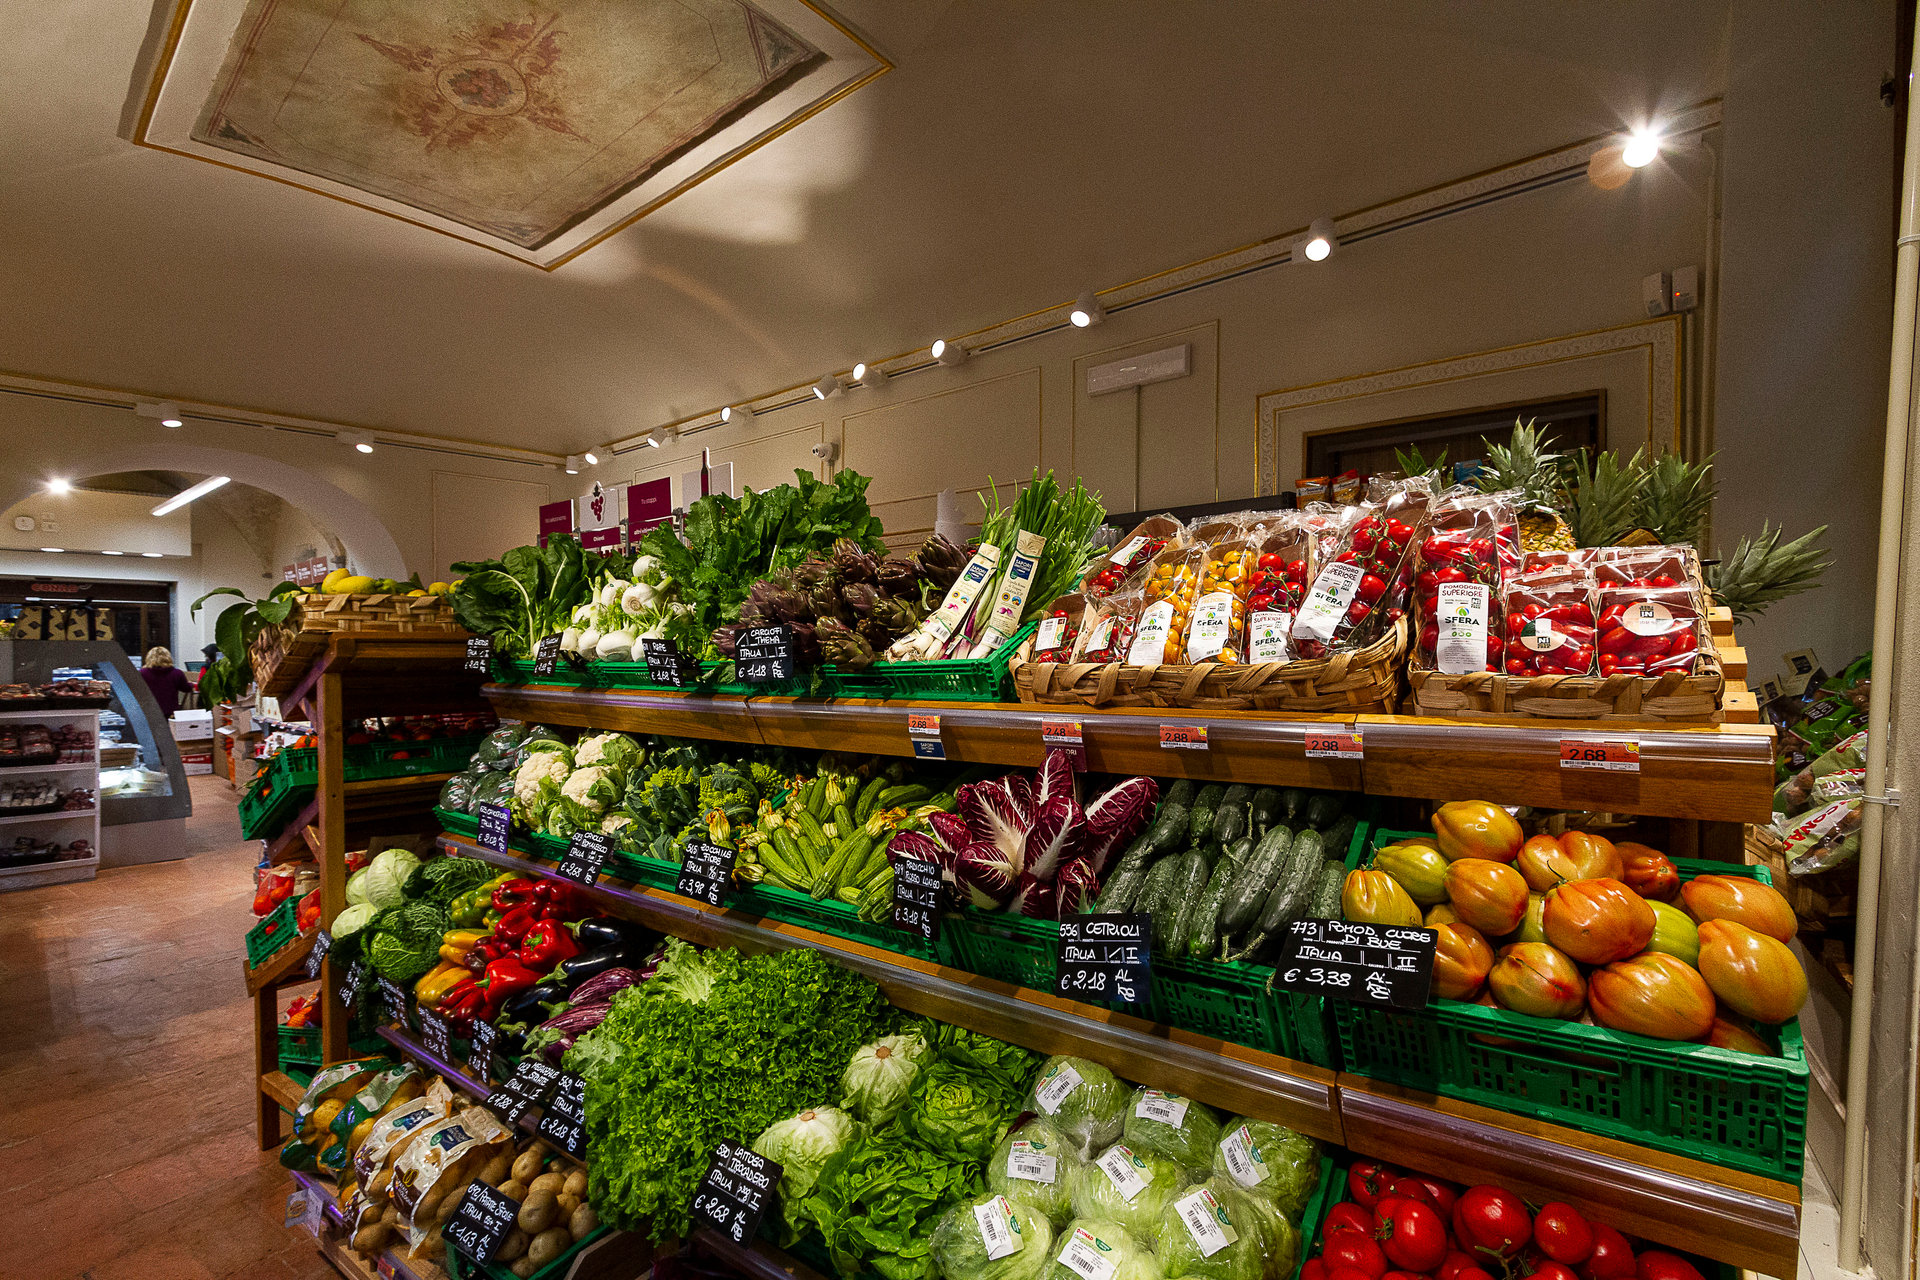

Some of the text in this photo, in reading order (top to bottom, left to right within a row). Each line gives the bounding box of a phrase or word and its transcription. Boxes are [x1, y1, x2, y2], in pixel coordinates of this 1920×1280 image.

[1442, 589, 1483, 597] SUPERIORE
[1444, 616, 1480, 626] SFERA
[1255, 637, 1282, 647] SFERA
[747, 664, 767, 678] 1,18
[1165, 732, 1188, 743] 2.88
[1311, 740, 1339, 751] 2.98
[1569, 748, 1606, 761] 2.68
[906, 860, 935, 875] RADICCHIO
[685, 879, 705, 895] 3,98
[902, 907, 919, 924] 3,18
[1059, 922, 1140, 937] 556 CETRIOLI
[1291, 920, 1431, 943] 773 POMOD. CUORE
[1343, 934, 1402, 950] DI BUE
[1065, 946, 1096, 960] ITALIA
[1299, 945, 1343, 962] ITALIA
[1061, 970, 1107, 991] € 2,18
[1114, 968, 1133, 982] AL
[1283, 968, 1352, 987] € 3,38
[734, 1146, 765, 1170] LATTUGA
[710, 1168, 733, 1191] ITALIA
[730, 1157, 770, 1189] TROCADERO
[694, 1194, 730, 1223] € 2,68
